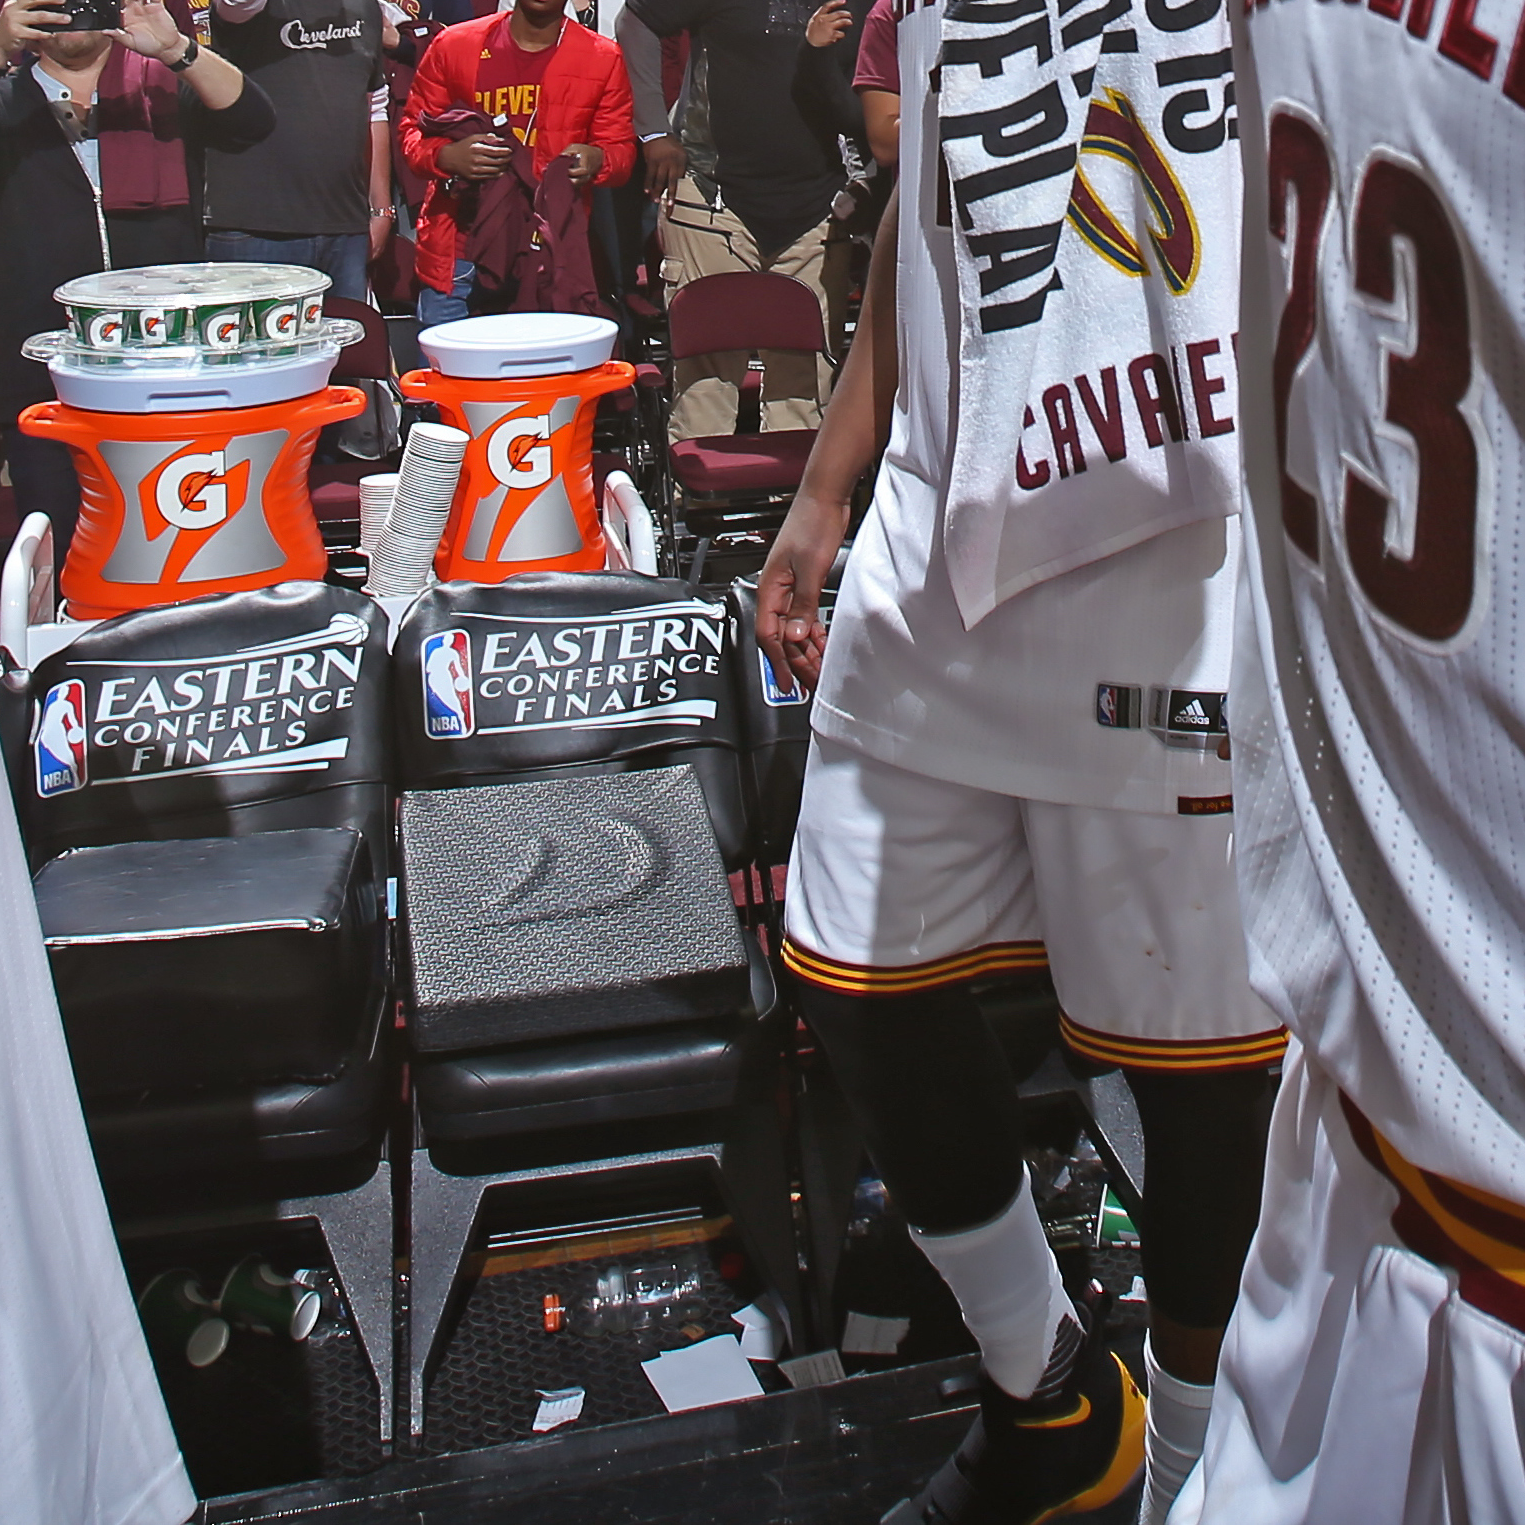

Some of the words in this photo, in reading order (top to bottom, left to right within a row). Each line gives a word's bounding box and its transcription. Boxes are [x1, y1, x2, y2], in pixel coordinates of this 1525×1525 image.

[279, 18, 363, 50] Cleveland
[1265, 97, 1493, 657] 23
[487, 414, 552, 489] G
[156, 451, 228, 531] G
[479, 617, 725, 675] EASTERN
[94, 646, 365, 724] EASTERN
[478, 652, 720, 699] CONFERENCE
[513, 679, 679, 724] FINALS
[93, 686, 356, 748] CONFERENCE
[431, 716, 460, 733] NBA
[131, 720, 308, 773] FINALS
[42, 769, 73, 791] NBA
